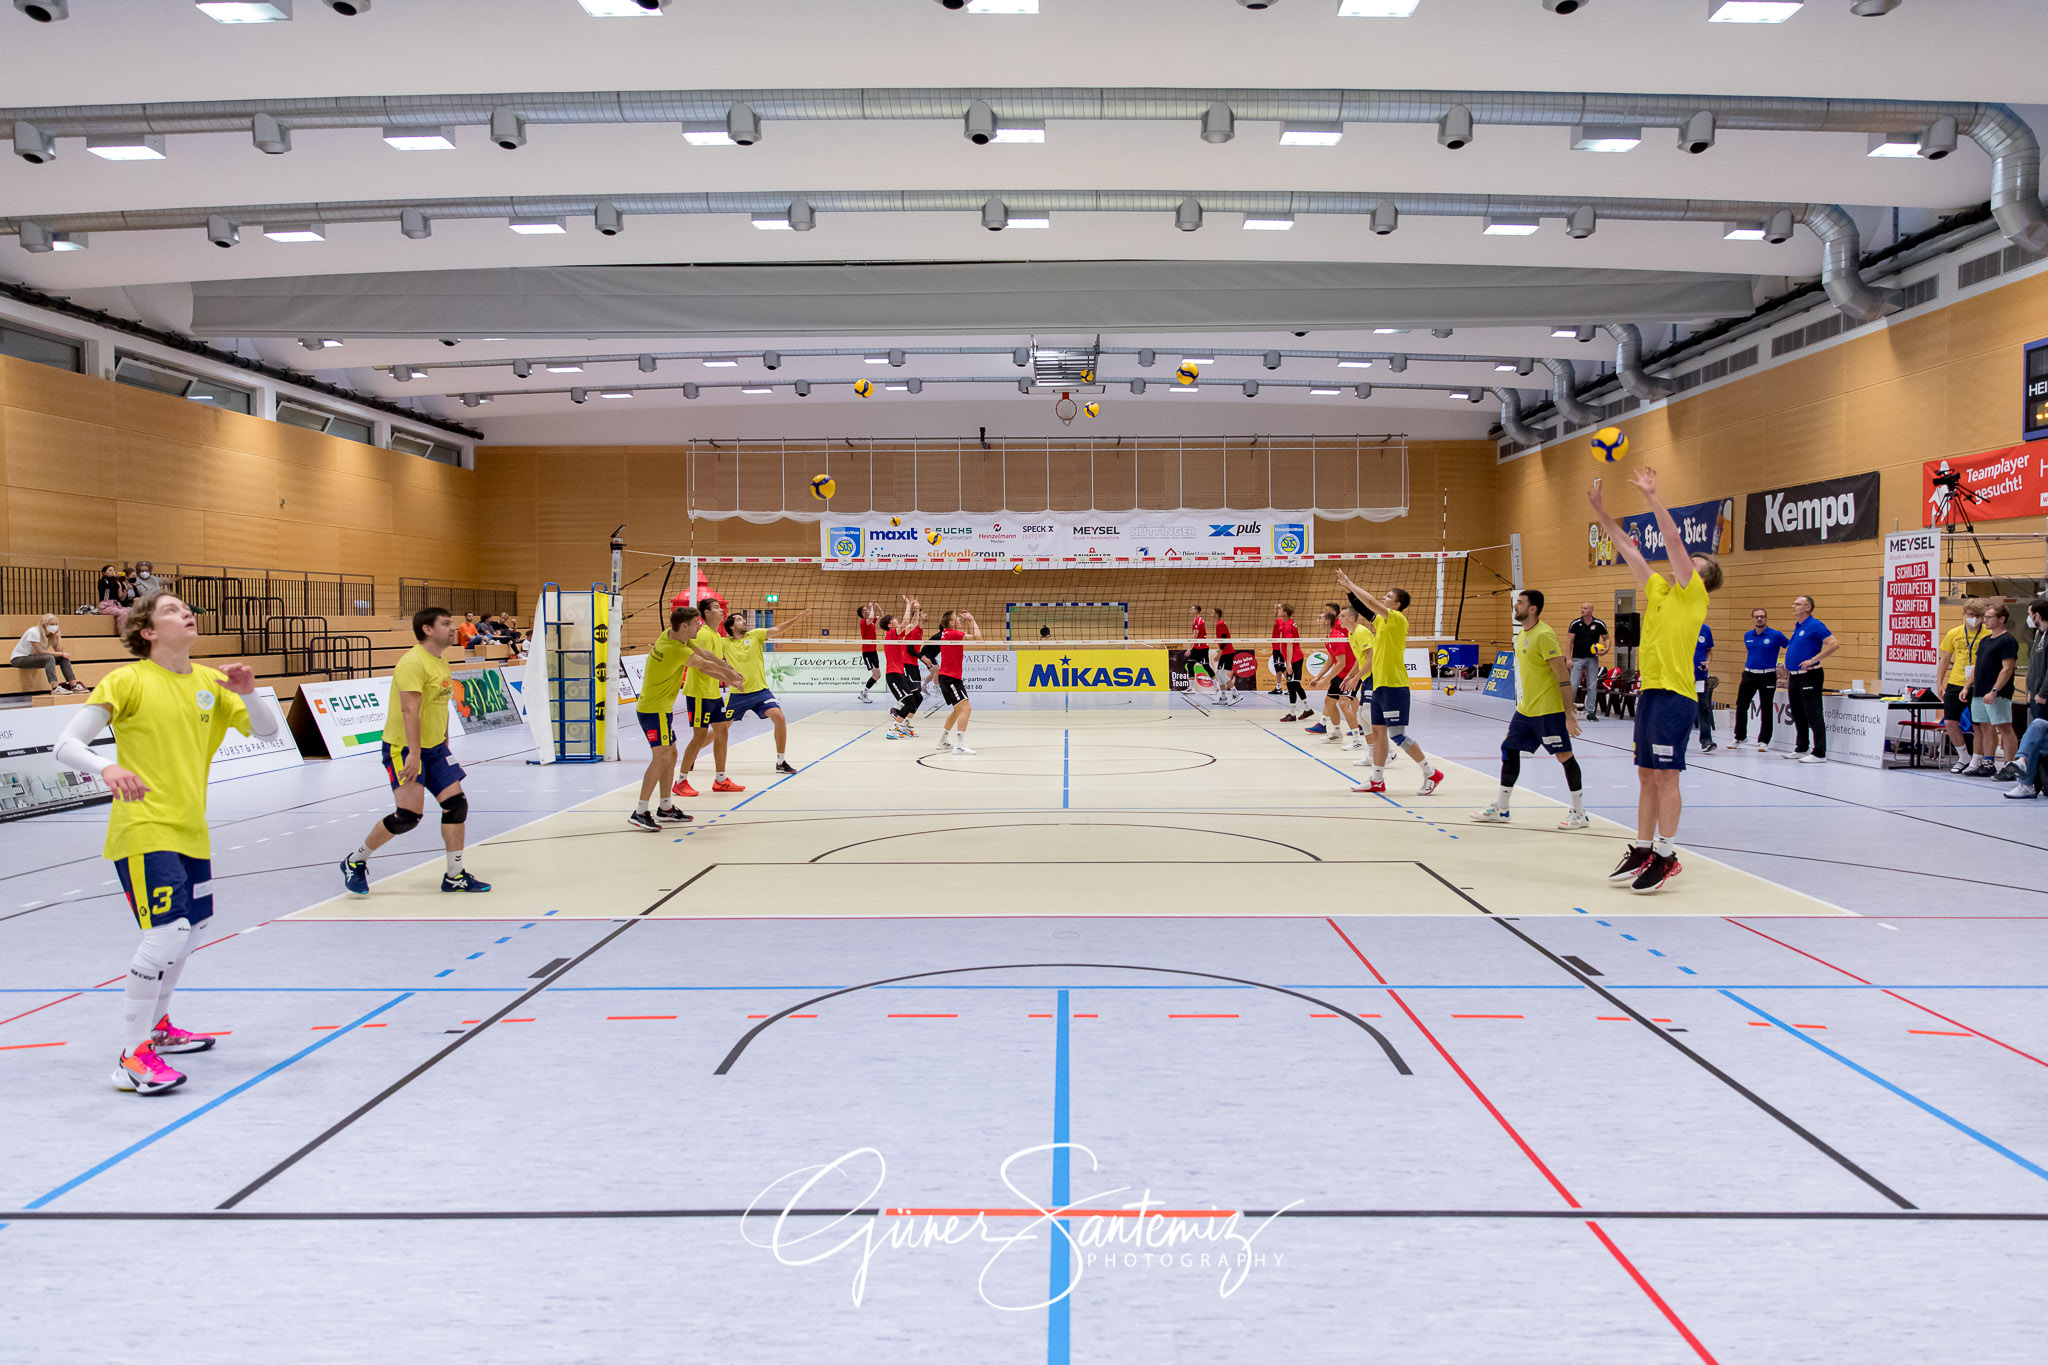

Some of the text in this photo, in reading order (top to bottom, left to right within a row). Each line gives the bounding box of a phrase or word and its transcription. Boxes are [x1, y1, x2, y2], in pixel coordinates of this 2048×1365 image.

[1966, 454, 2030, 483] Teamplayer
[1974, 475, 2022, 505] gesucht!
[1764, 492, 1855, 540] Kempa
[870, 528, 918, 540] maxit
[1073, 526, 1120, 535] MEYSEL
[1236, 521, 1262, 536] puls
[1684, 516, 1708, 544] Bier
[1890, 536, 1935, 552] MEYSEL
[1896, 564, 1926, 580] SCHILDER
[1889, 581, 1933, 596] FOTOTAPETEN
[1895, 600, 1928, 612] SCHRIFTEN
[1891, 616, 1932, 630] KLEBEFOLIEN
[1894, 632, 1931, 647] FAHRZEUG-
[792, 656, 848, 666] Taverna
[964, 654, 1010, 663] ARTNER
[1888, 648, 1936, 663] BESCHRIFTUNG
[329, 692, 380, 712] FUCHS
[337, 712, 385, 726] Ideen umsetzen
[703, 712, 710, 723] 5
[726, 709, 735, 718] 8
[1825, 710, 1881, 725] roßformatdruck
[1826, 724, 1866, 737] erbetechnik
[152, 886, 173, 915] 3
